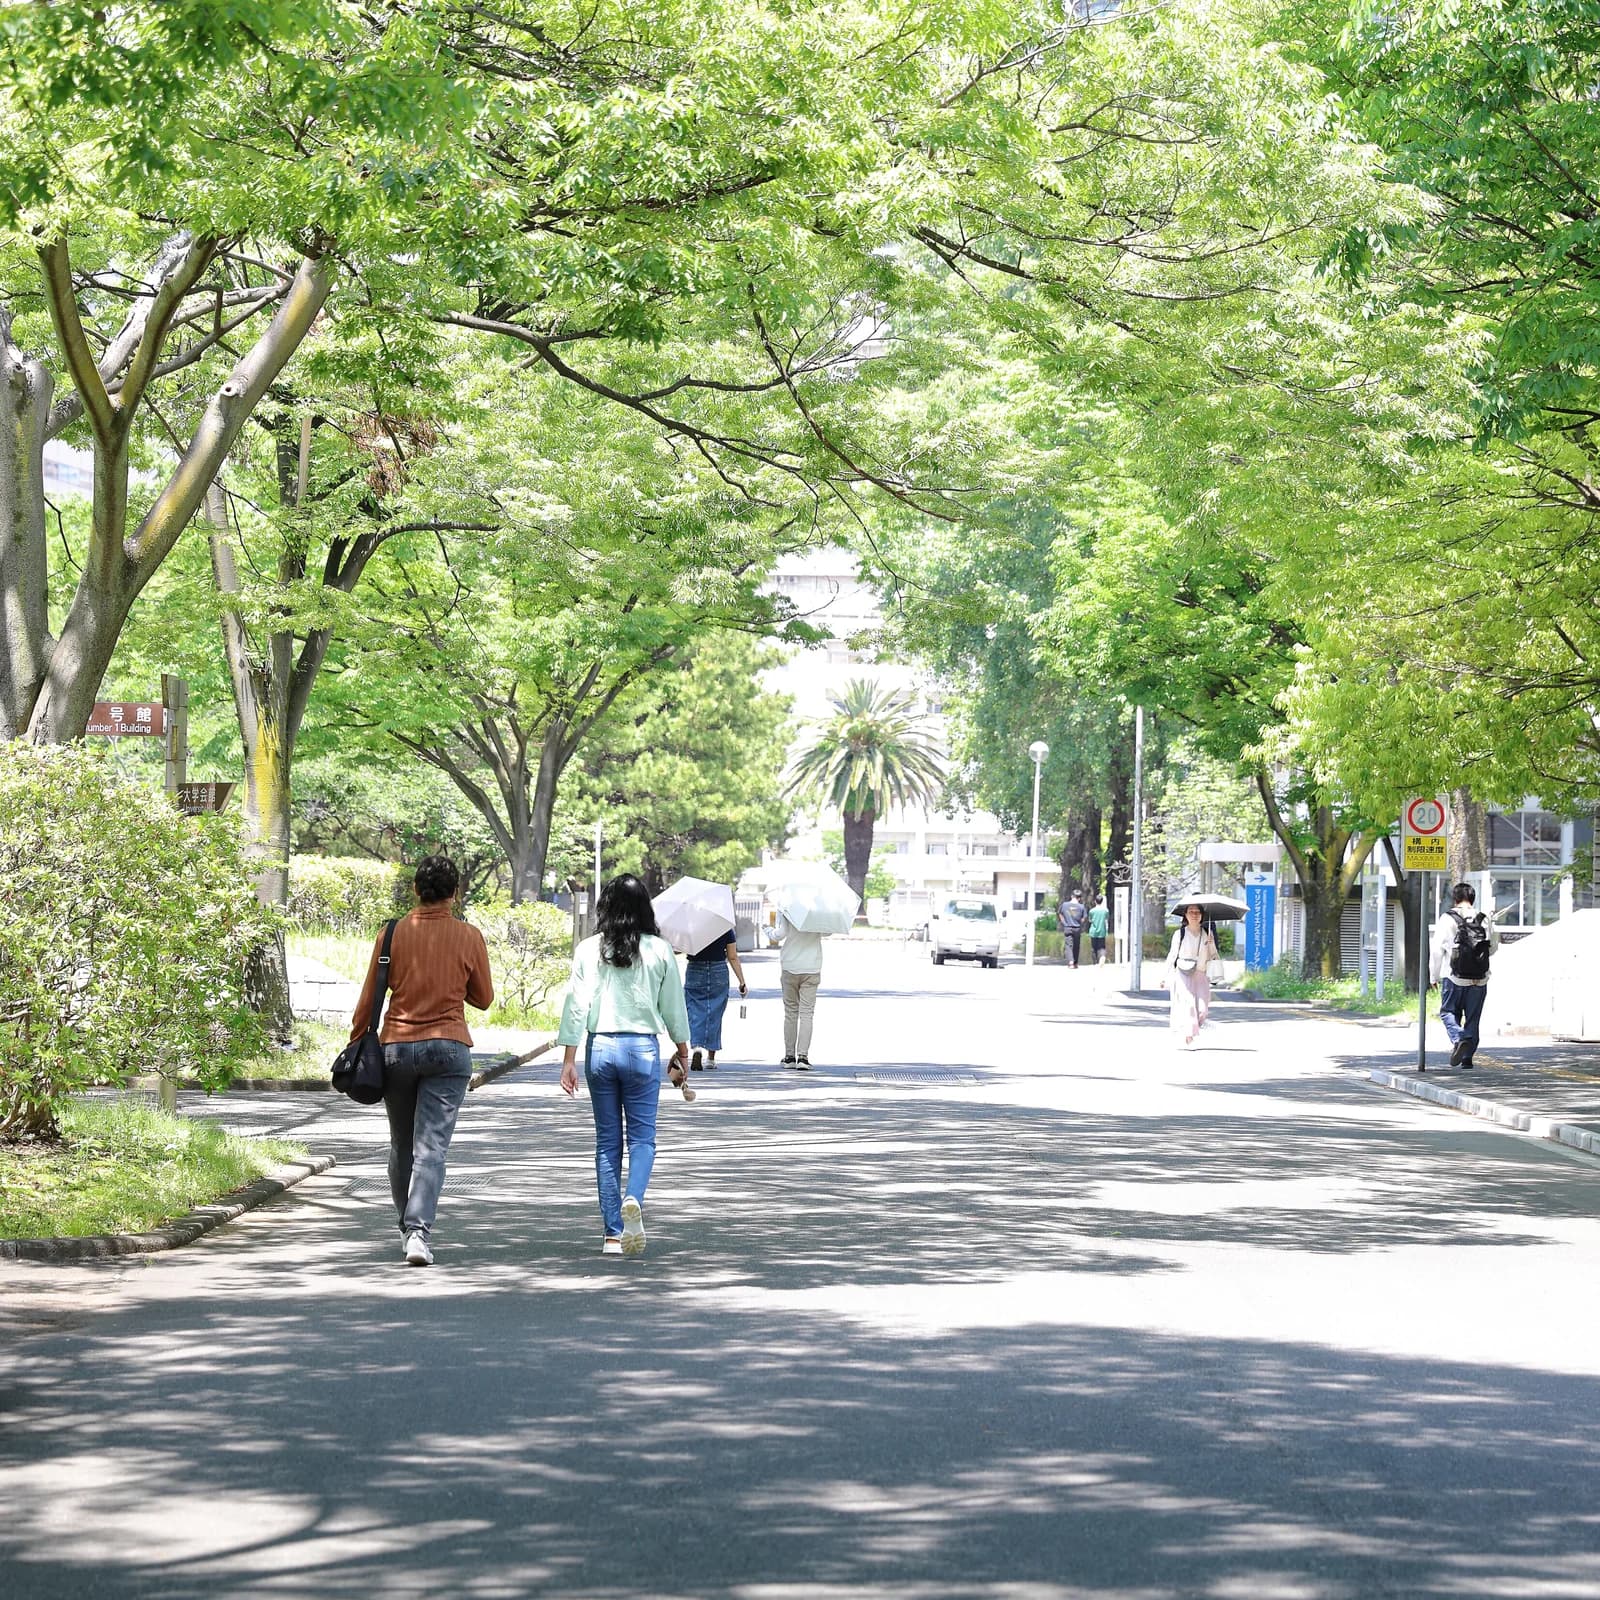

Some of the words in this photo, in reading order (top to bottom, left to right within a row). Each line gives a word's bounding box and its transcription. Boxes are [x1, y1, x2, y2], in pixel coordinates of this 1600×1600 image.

[89, 706, 152, 722] 号館
[120, 723, 151, 733] Building
[1417, 807, 1437, 824] 20
